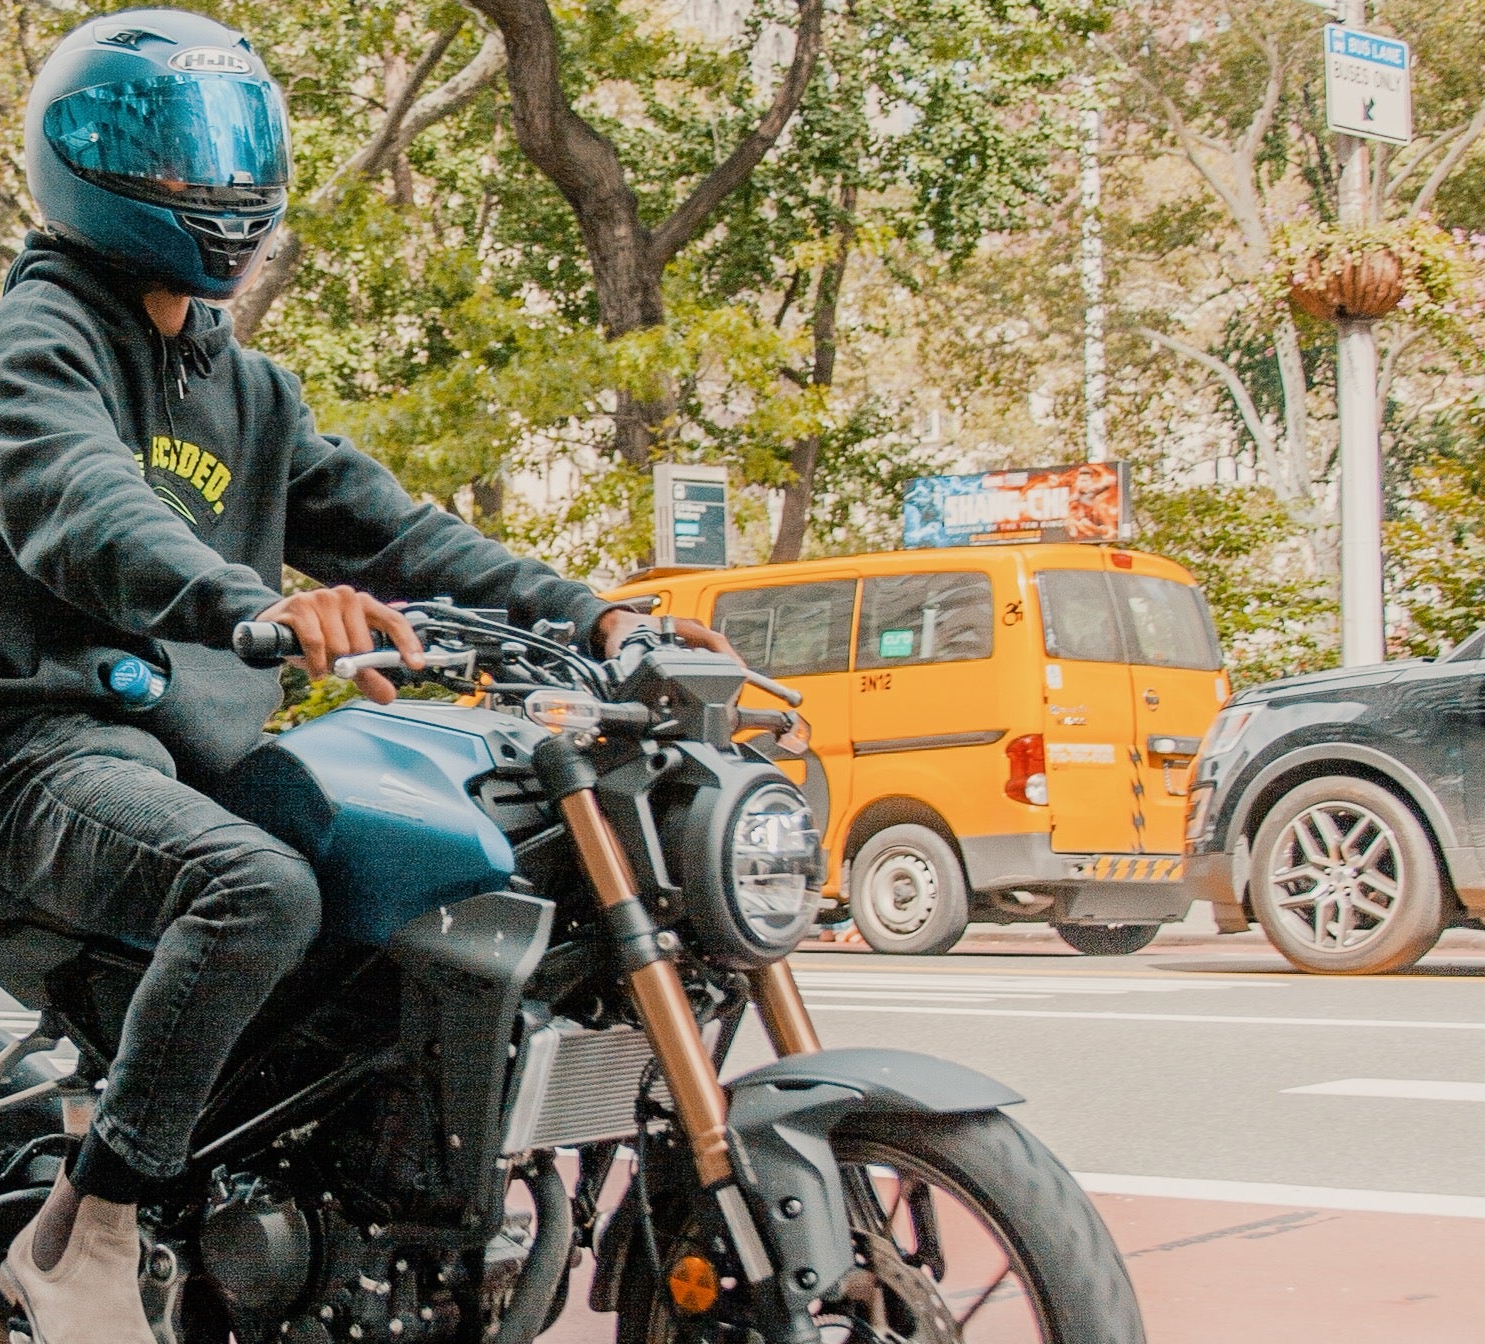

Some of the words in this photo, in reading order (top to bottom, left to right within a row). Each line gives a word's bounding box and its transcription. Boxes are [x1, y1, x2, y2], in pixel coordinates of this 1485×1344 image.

[184, 53, 244, 70] HJC
[1347, 36, 1371, 57] BUS
[1371, 43, 1403, 64] LANE
[1334, 60, 1369, 86] BUSES
[1374, 70, 1402, 93] ONLY
[944, 487, 1070, 526] SHANG-CHI
